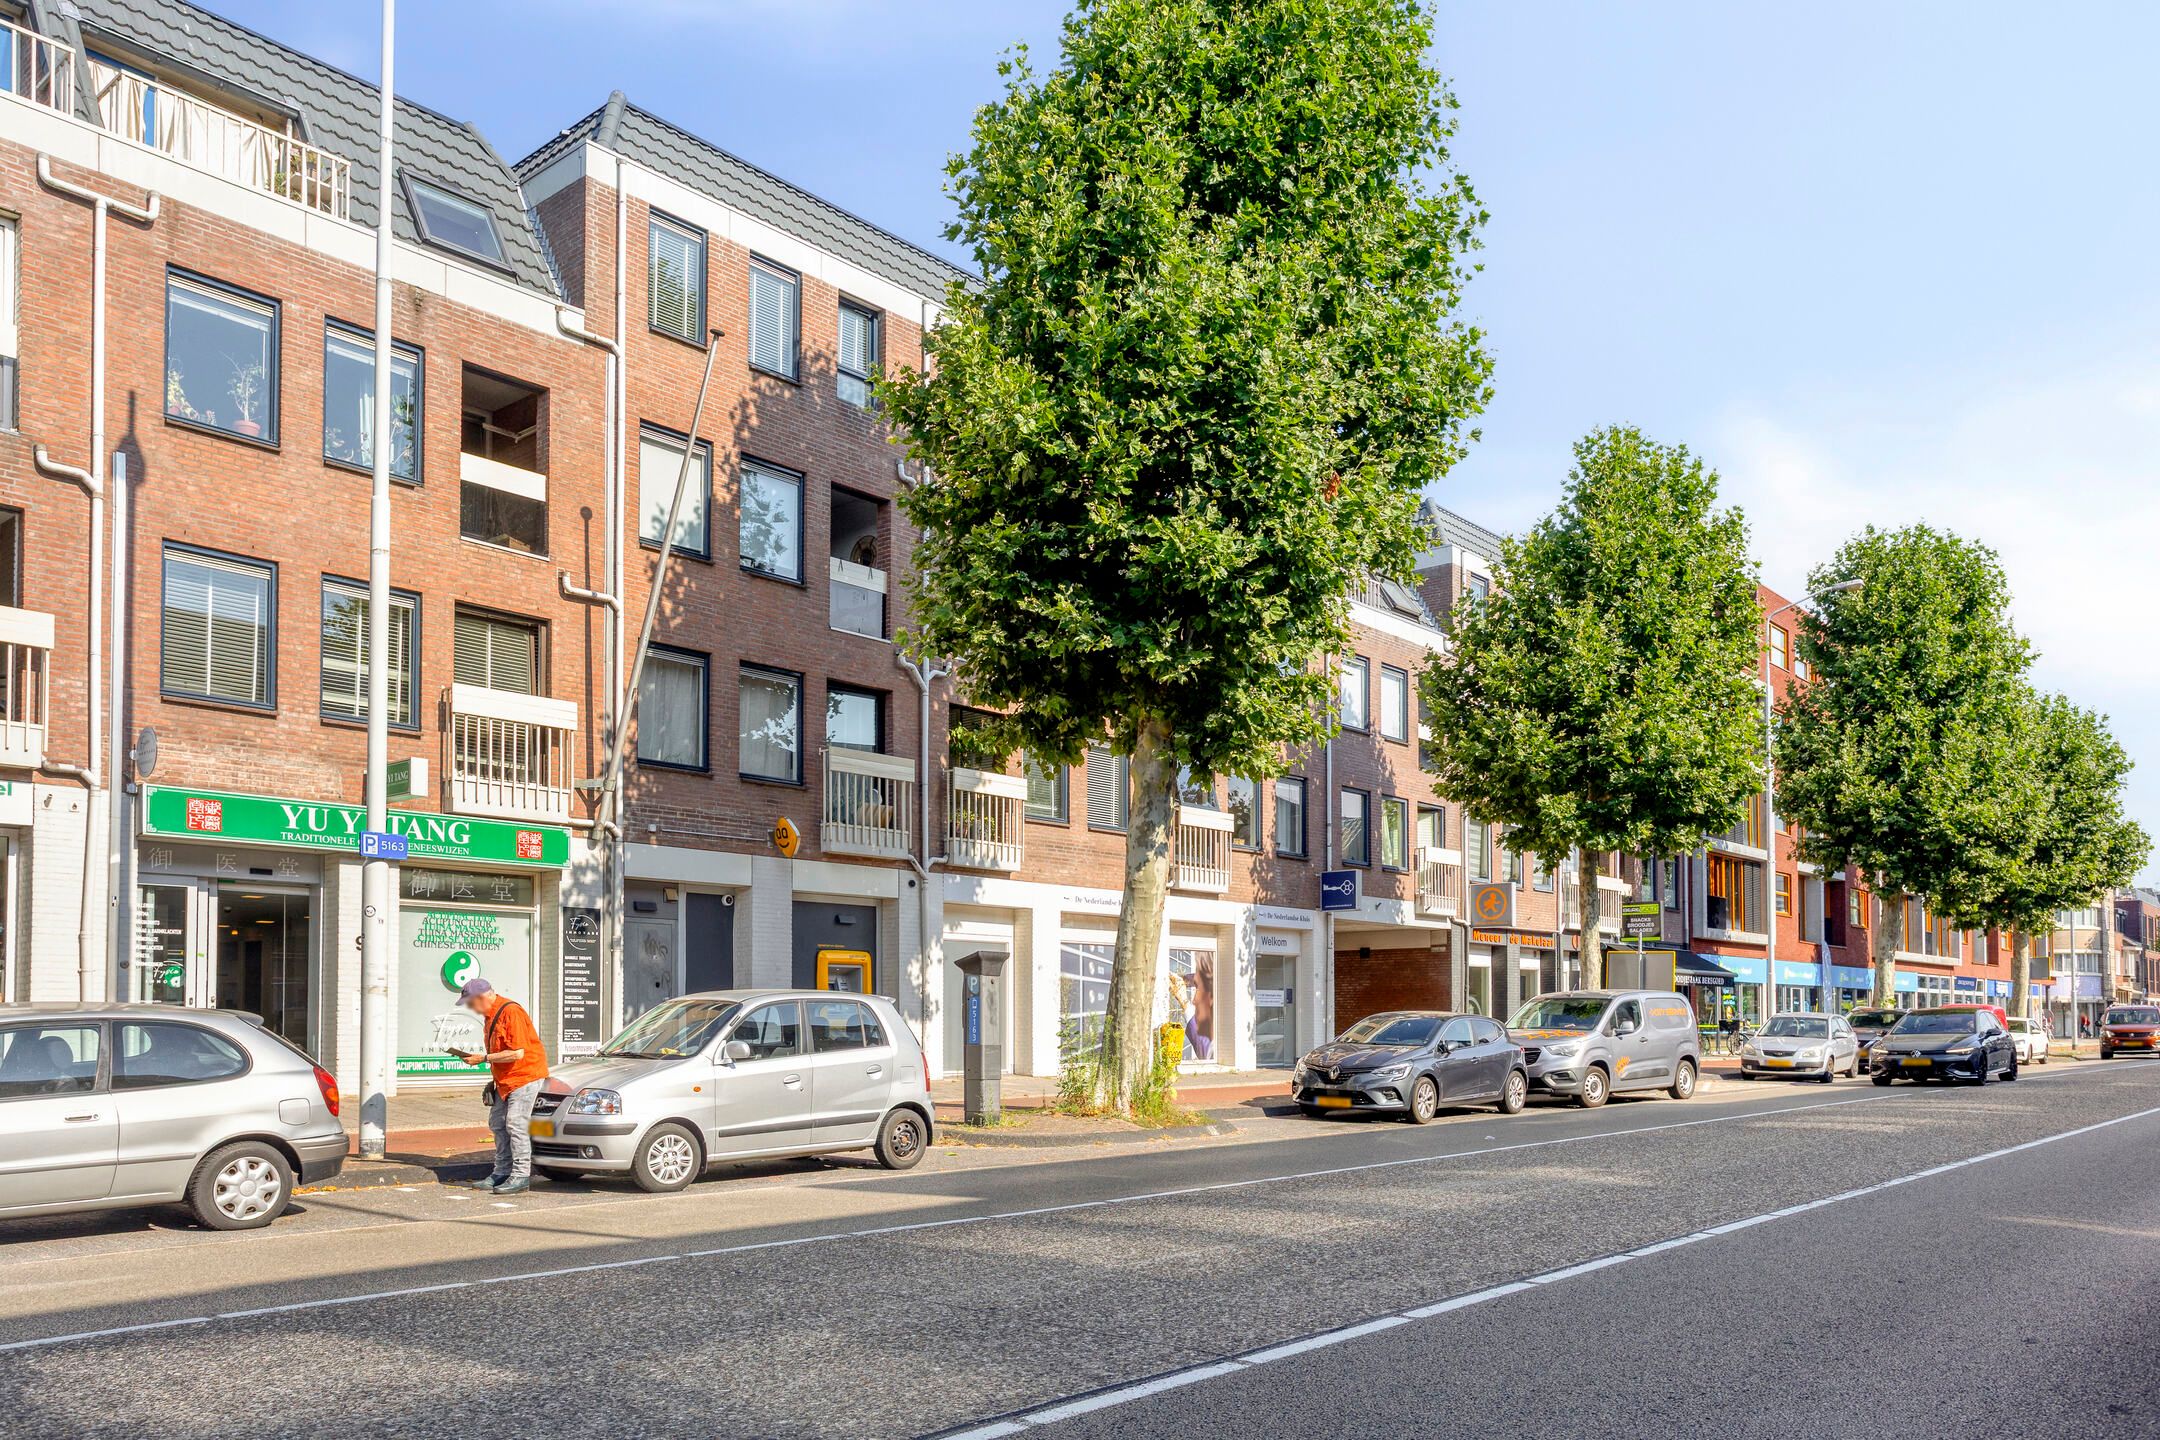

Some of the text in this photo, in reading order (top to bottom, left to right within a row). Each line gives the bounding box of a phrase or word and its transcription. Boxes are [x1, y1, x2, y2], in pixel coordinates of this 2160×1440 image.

[280, 804, 471, 845] YU Y TANG
[280, 832, 470, 855] TRADITIONELE ENEESWIJZEN
[381, 841, 405, 852] 5163
[1261, 936, 1288, 947] Welkom
[1473, 930, 1502, 943] Meneer
[1509, 934, 1519, 944] de
